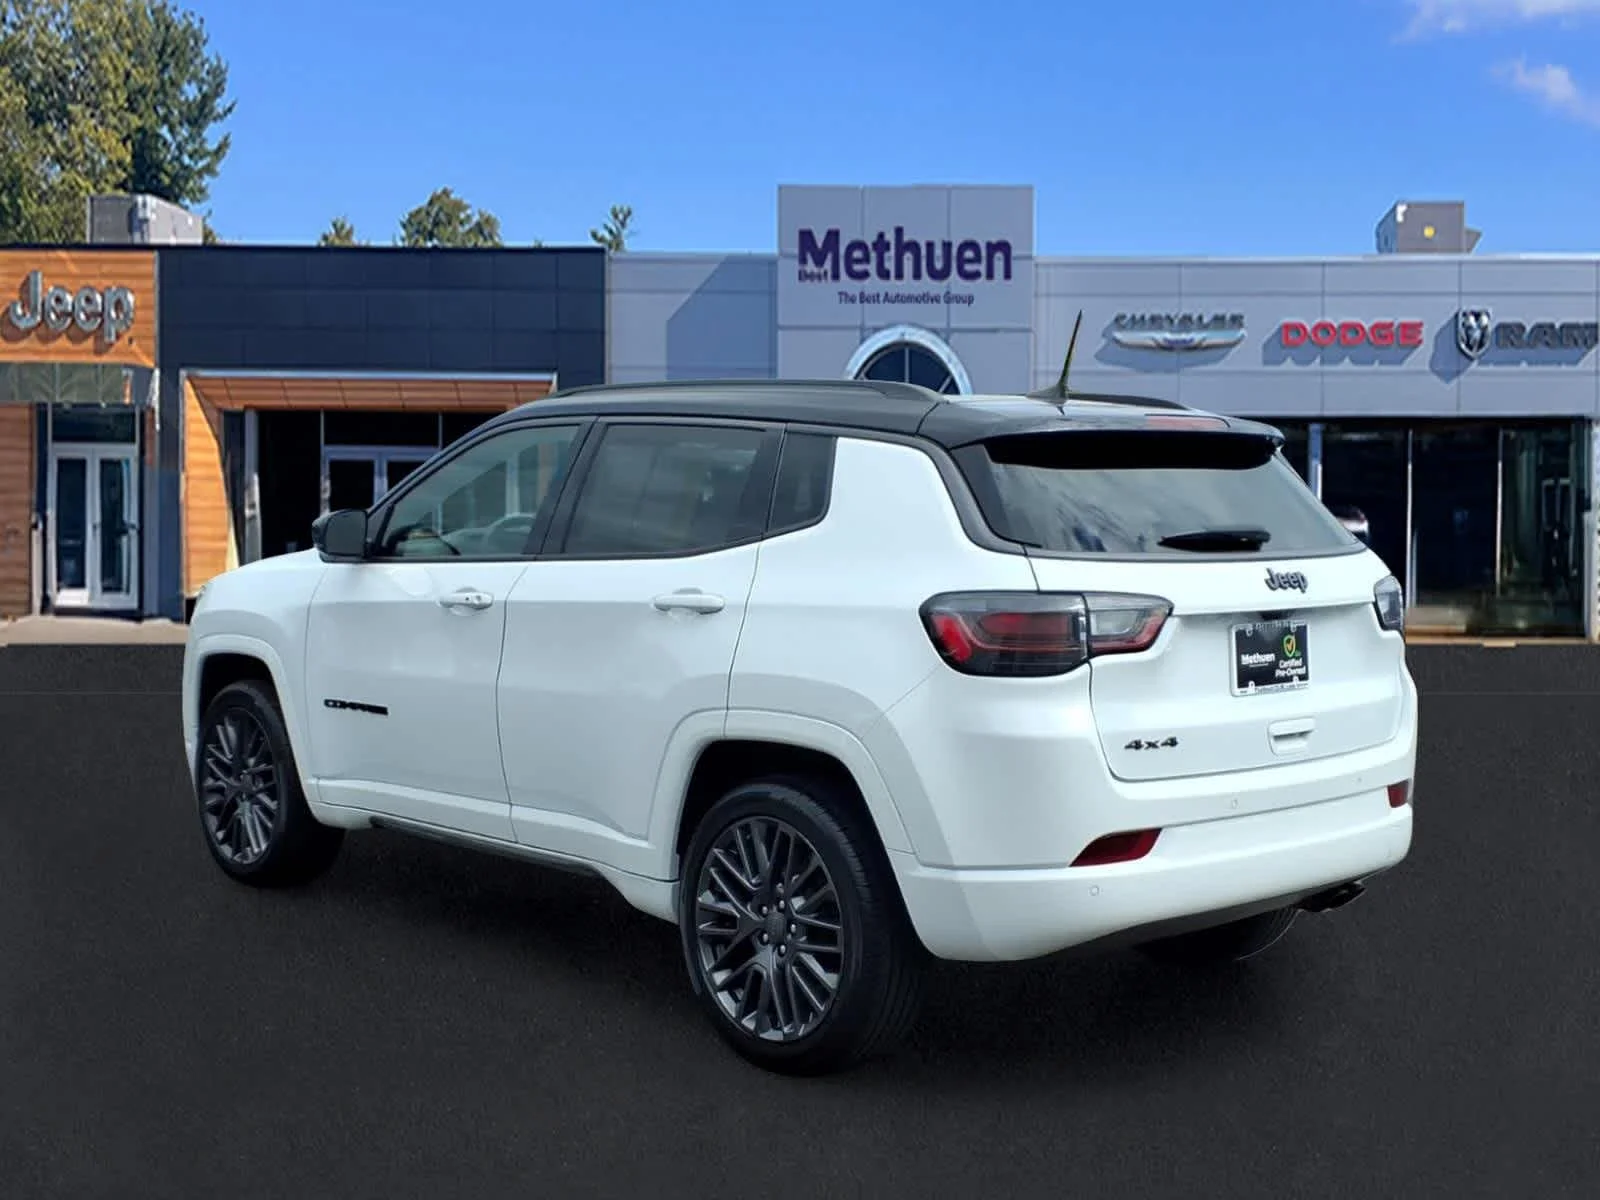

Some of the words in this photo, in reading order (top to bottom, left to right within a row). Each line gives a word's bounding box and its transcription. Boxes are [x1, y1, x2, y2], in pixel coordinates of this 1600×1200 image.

[798, 226, 1012, 281] Methuen
[9, 270, 135, 344] Jeep
[837, 291, 857, 304] The
[859, 292, 880, 304] Best
[883, 291, 941, 305] Automotive
[944, 291, 974, 306] Group
[1281, 321, 1424, 347] DODGE
[1495, 322, 1599, 349] RAM
[1264, 568, 1308, 593] Jeep
[1124, 736, 1179, 750] 4x4
